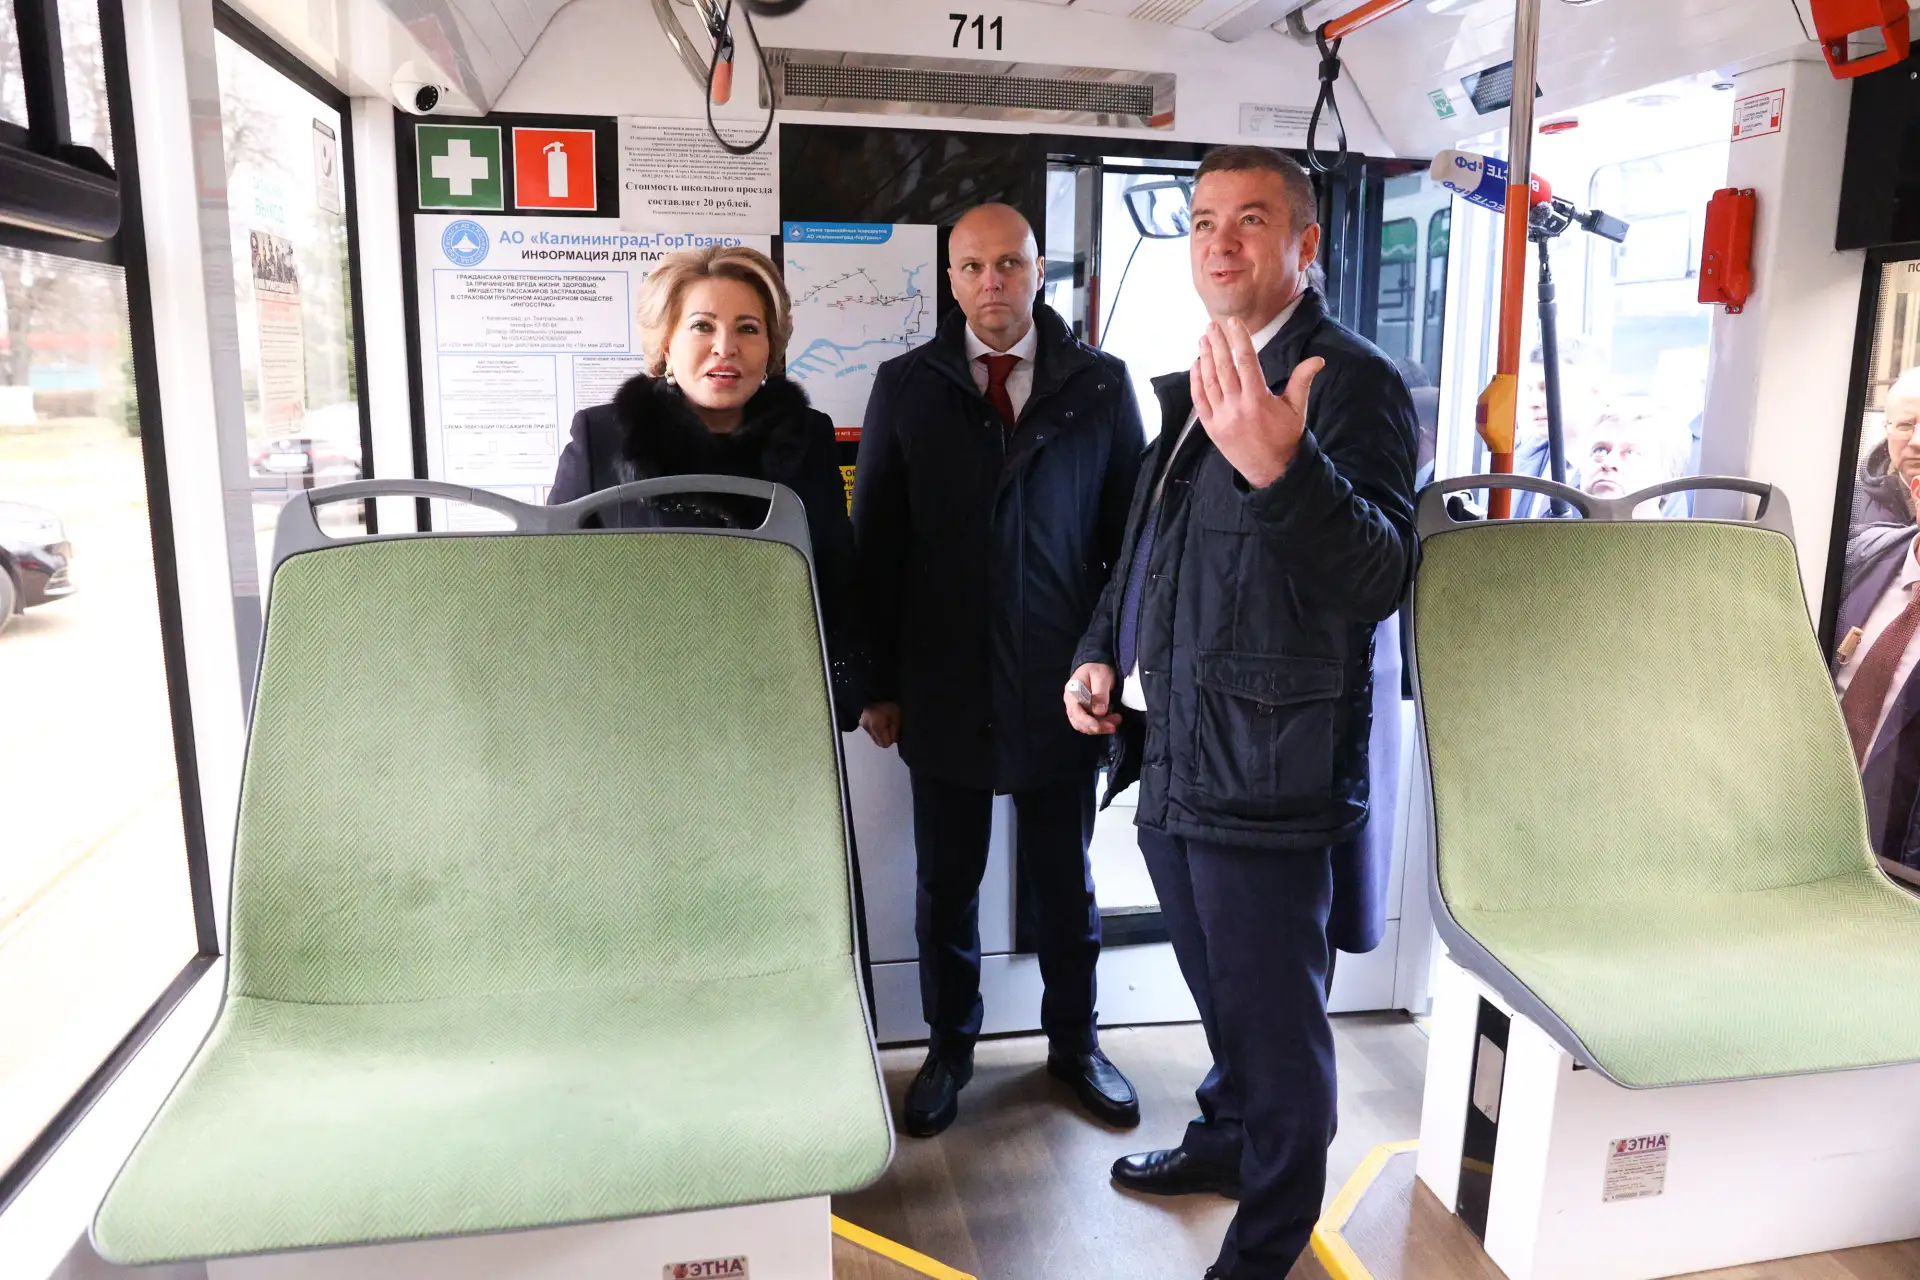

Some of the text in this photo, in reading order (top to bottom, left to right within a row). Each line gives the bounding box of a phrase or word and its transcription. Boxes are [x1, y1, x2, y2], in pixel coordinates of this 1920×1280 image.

[949, 13, 1002, 50] 711
[626, 182, 678, 191] Стоимость
[736, 186, 772, 195] проезда
[648, 198, 752, 209] составляет 20 рублей.
[499, 230, 742, 249] АО «Калининград-ГорТранс»
[522, 250, 609, 262] ИНФОРМАЦИЯ
[612, 251, 637, 262] ДЛЯ
[1628, 1134, 1666, 1151] ЭТНА
[690, 1258, 742, 1276] ЭТНА
